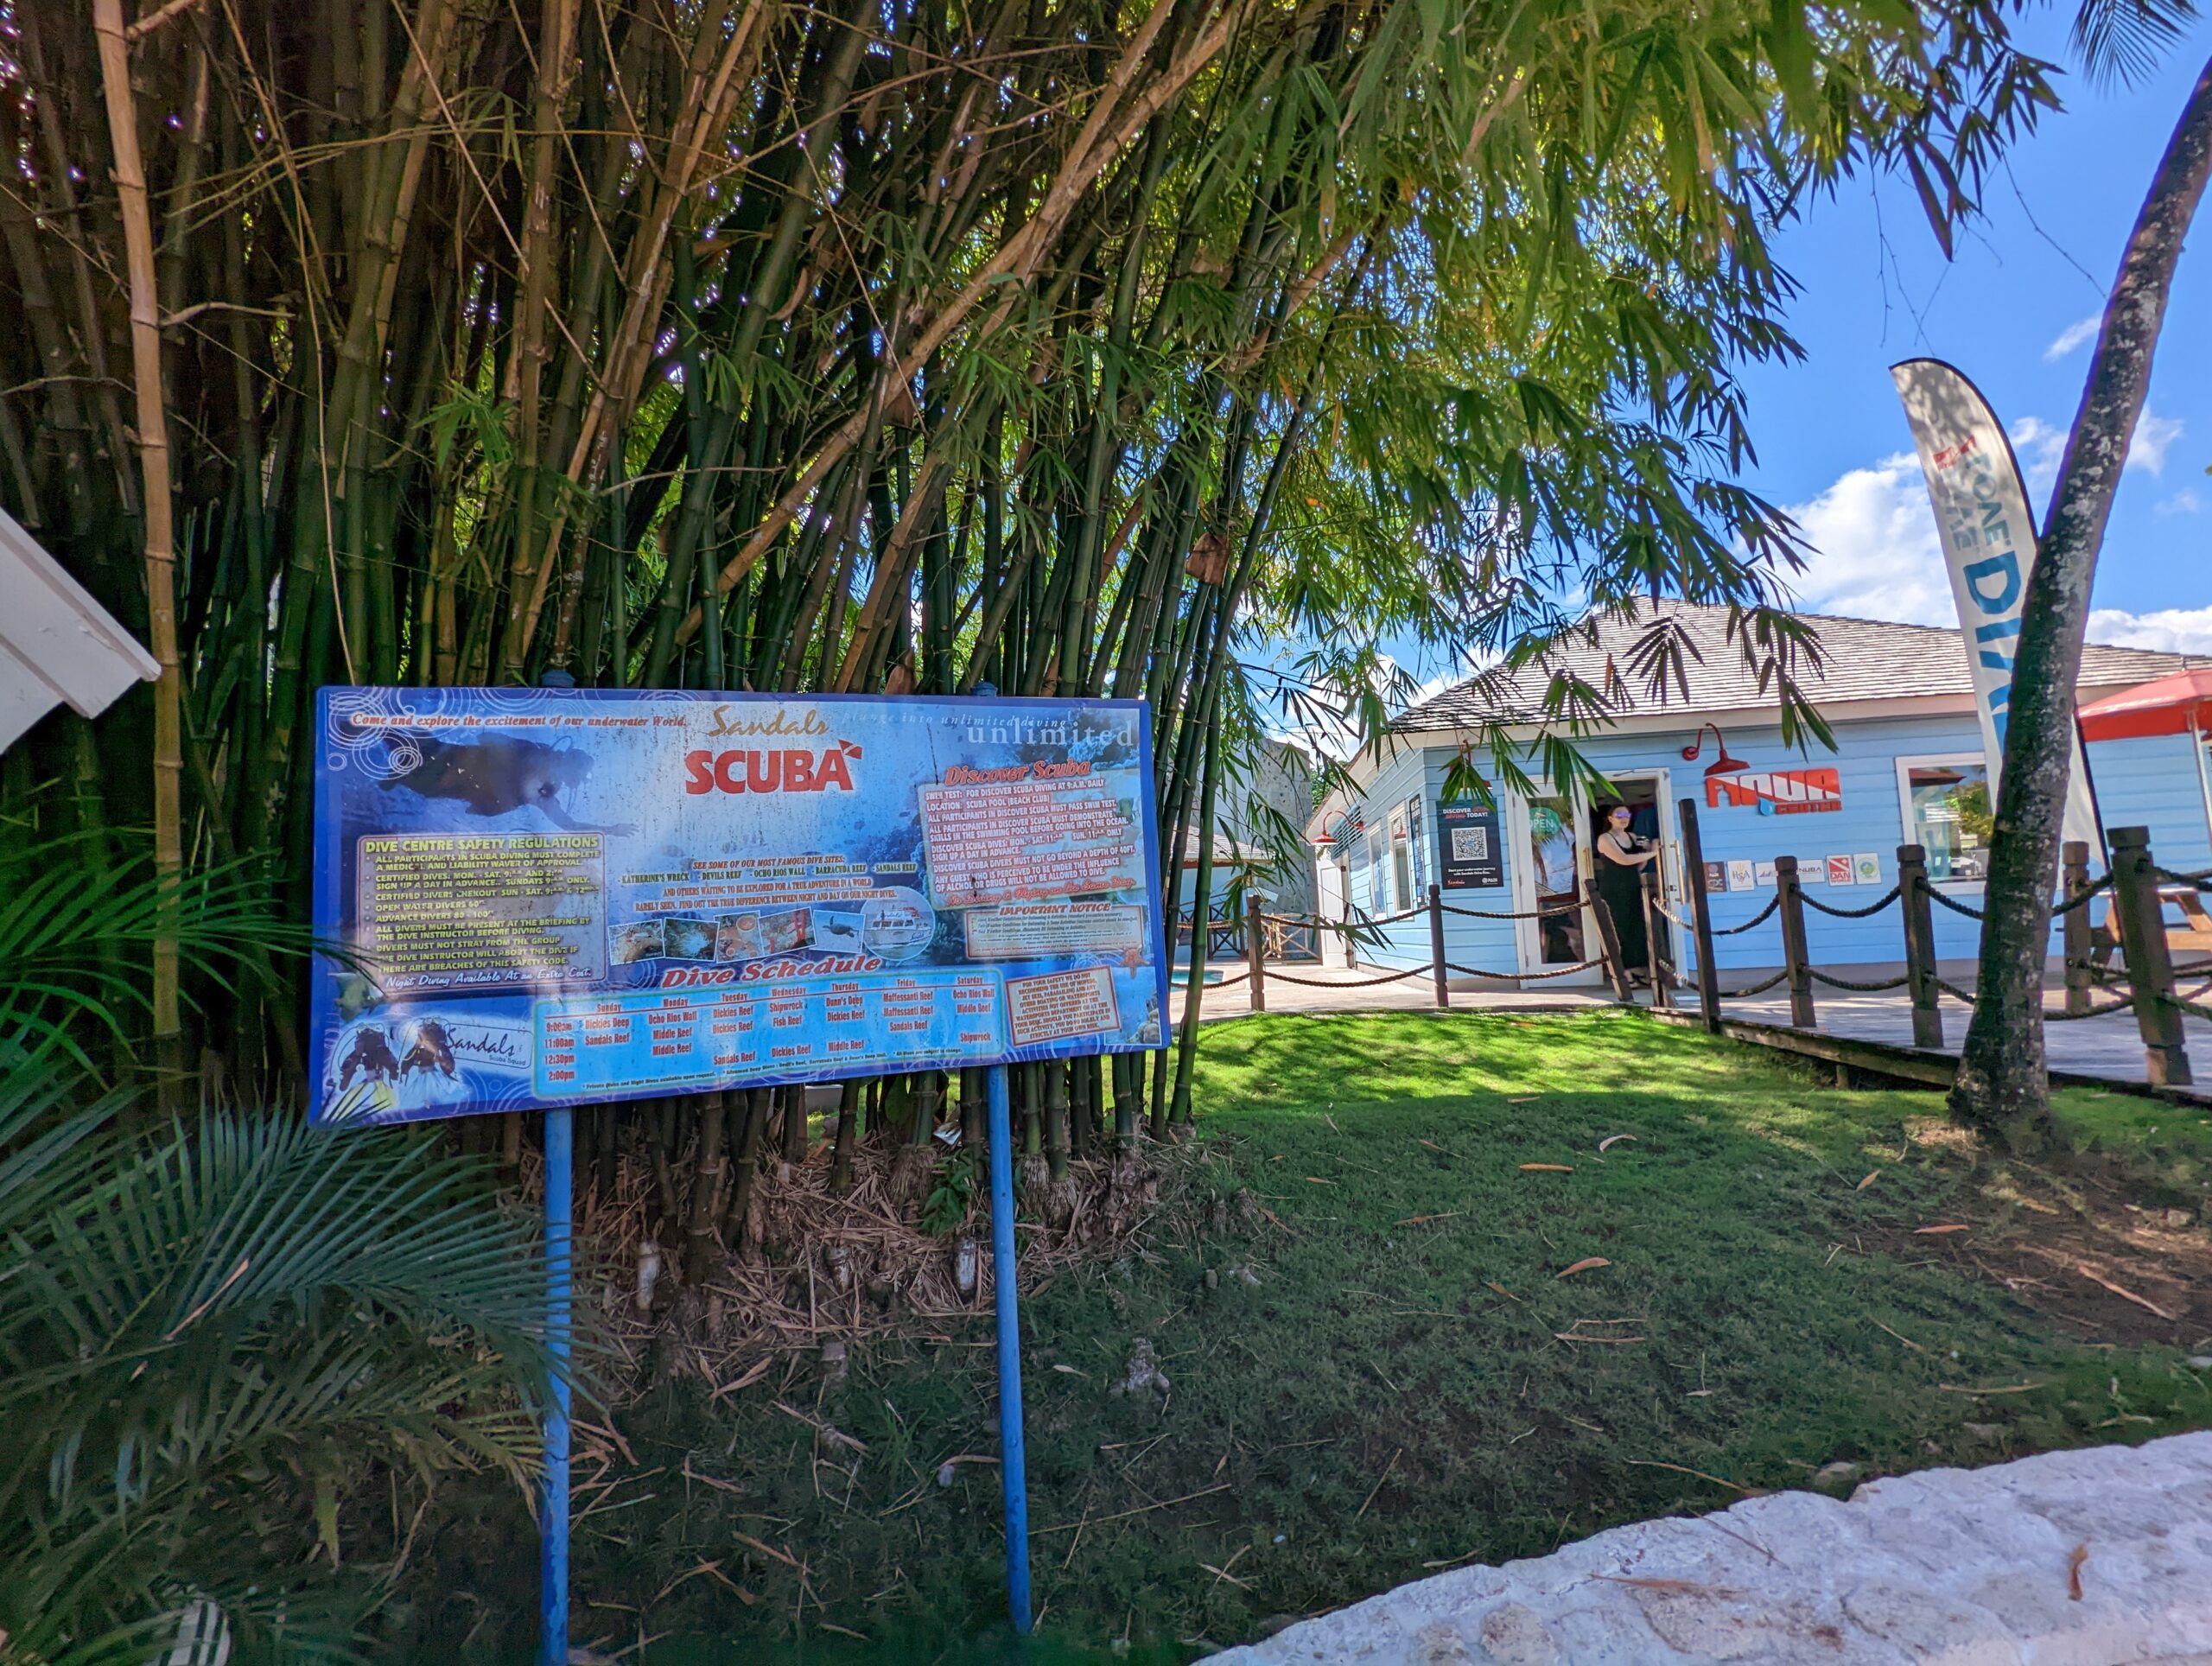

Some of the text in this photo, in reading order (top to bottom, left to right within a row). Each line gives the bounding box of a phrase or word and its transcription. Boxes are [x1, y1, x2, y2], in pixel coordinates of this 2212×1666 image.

[353, 714, 387, 725] Come
[391, 715, 414, 725] and
[417, 715, 460, 727] explore
[463, 715, 480, 725] the
[485, 716, 546, 726] excitement
[550, 715, 562, 727] of
[707, 705, 830, 737] Sandals
[967, 717, 1135, 746] unlimited
[684, 749, 855, 794] SCUBA
[945, 758, 1091, 785] Discover Scuba
[981, 787, 1011, 796] DISCOVER
[1013, 785, 1033, 793] SCUBA
[1035, 783, 1056, 792] DIVING
[1707, 768, 1840, 807] AQUA
[967, 800, 987, 809] SCUBA
[942, 811, 987, 822] PARTICIPANTS
[997, 808, 1027, 817] DISCOVER
[1029, 805, 1049, 814] SCUBA
[365, 837, 598, 852] DIVE CENTRE SAFETY REGULATIONS
[470, 852, 498, 861] SCUBA
[449, 861, 489, 869] LIABILITY
[702, 871, 724, 880] DEVILS
[789, 867, 805, 875] WALL
[817, 865, 849, 874] BARRACUDA
[1000, 903, 1110, 915] IMPORTANT NOTICE
[376, 913, 418, 922] ADVANCE
[396, 924, 425, 932] DIVERS
[421, 930, 474, 938] INSTRUCTOR
[377, 944, 407, 952] DIVERS
[397, 949, 496, 961] DIVE INSTRUCTOR WILL
[429, 962, 473, 970] BREACHES
[662, 956, 880, 988] Dive Schedule
[386, 971, 501, 989] Night Diving Available
[598, 1003, 621, 1013] Sunday
[664, 998, 689, 1008] Monday
[722, 994, 747, 1002] Tuesday
[772, 987, 806, 996] Wednesday
[832, 982, 859, 991] Thursday
[957, 976, 982, 985] Saturday
[586, 1020, 610, 1030] Dickies
[613, 1018, 629, 1028] Deep
[649, 1014, 664, 1024] Ocho
[667, 1013, 681, 1022] Rios
[714, 1008, 737, 1018] Dickies
[740, 1006, 753, 1015] Reef
[827, 997, 846, 1007] Dunn's
[849, 996, 862, 1006] Deep
[920, 991, 933, 1001] Reef
[969, 989, 981, 998] Rios
[545, 1038, 574, 1048] 11:00am
[586, 1035, 612, 1046] Sandals
[615, 1033, 629, 1043] Reef
[653, 1030, 675, 1040] Middle
[713, 1024, 736, 1034] Dickies
[739, 1022, 753, 1032] Reef
[773, 1018, 785, 1027] Fish
[788, 1015, 802, 1026] Reef
[828, 1012, 849, 1022] Dickies
[852, 1010, 864, 1020] Reef
[920, 1006, 933, 1014] Reef
[957, 1004, 976, 1013] Middle
[448, 1027, 515, 1057] Sandals
[545, 1021, 927, 1065] 12:30pm Middle Reef Sandals Reef
[549, 1040, 864, 1081] 2:00pm Sandals Reef Dickies Reef Middle Reef
